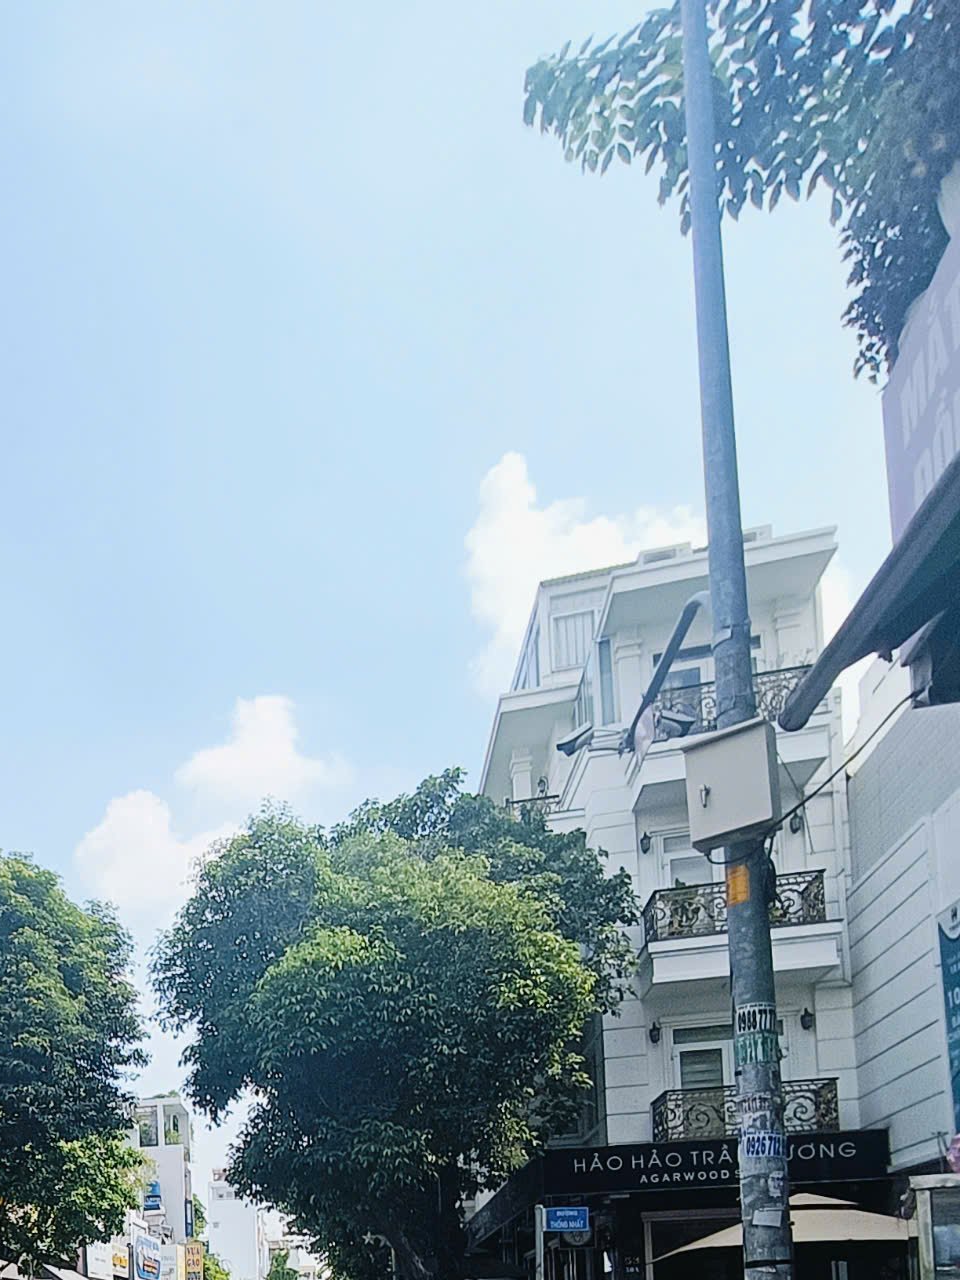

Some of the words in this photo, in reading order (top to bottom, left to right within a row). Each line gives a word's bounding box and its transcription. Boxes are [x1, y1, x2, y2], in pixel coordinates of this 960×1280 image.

[574, 1151, 623, 1173] HẢO
[632, 1149, 682, 1169] HẢO
[690, 1144, 740, 1166] TRẦ
[640, 1169, 730, 1183] AGARWOOD
